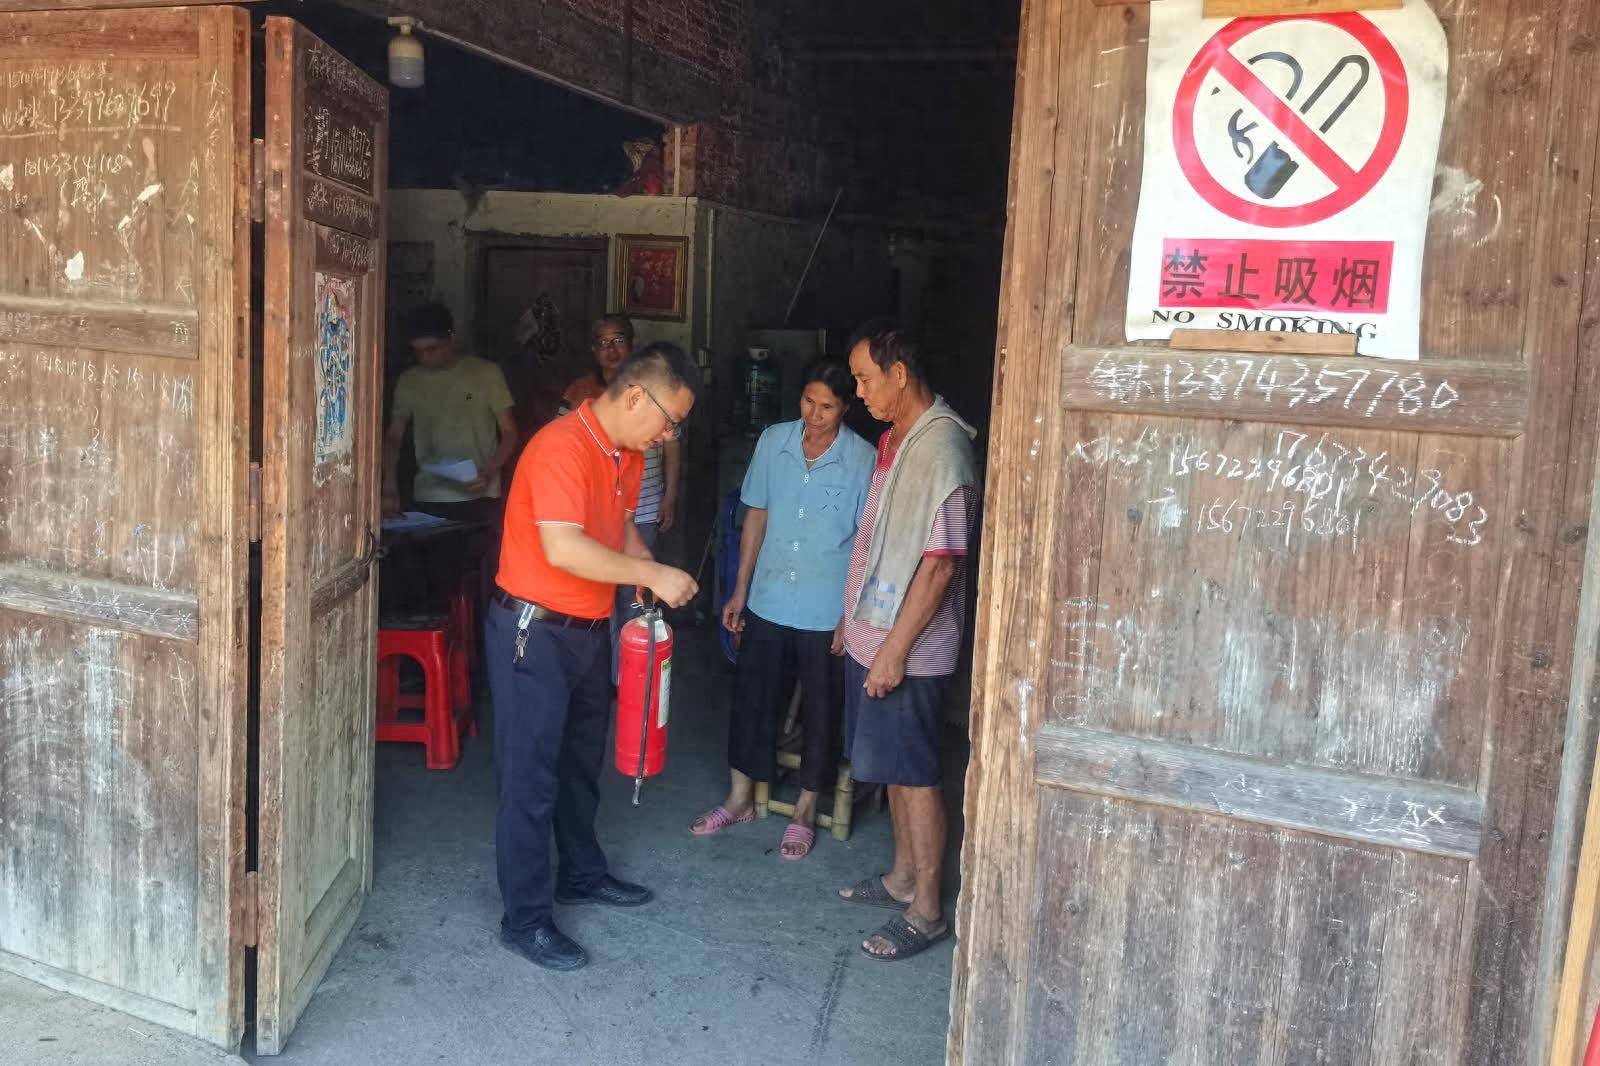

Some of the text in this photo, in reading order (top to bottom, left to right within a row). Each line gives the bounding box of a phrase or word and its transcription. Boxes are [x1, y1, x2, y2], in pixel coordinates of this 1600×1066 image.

[1162, 247, 1380, 309] 禁止吸烟
[1151, 310, 1378, 340] NO SMOKING
